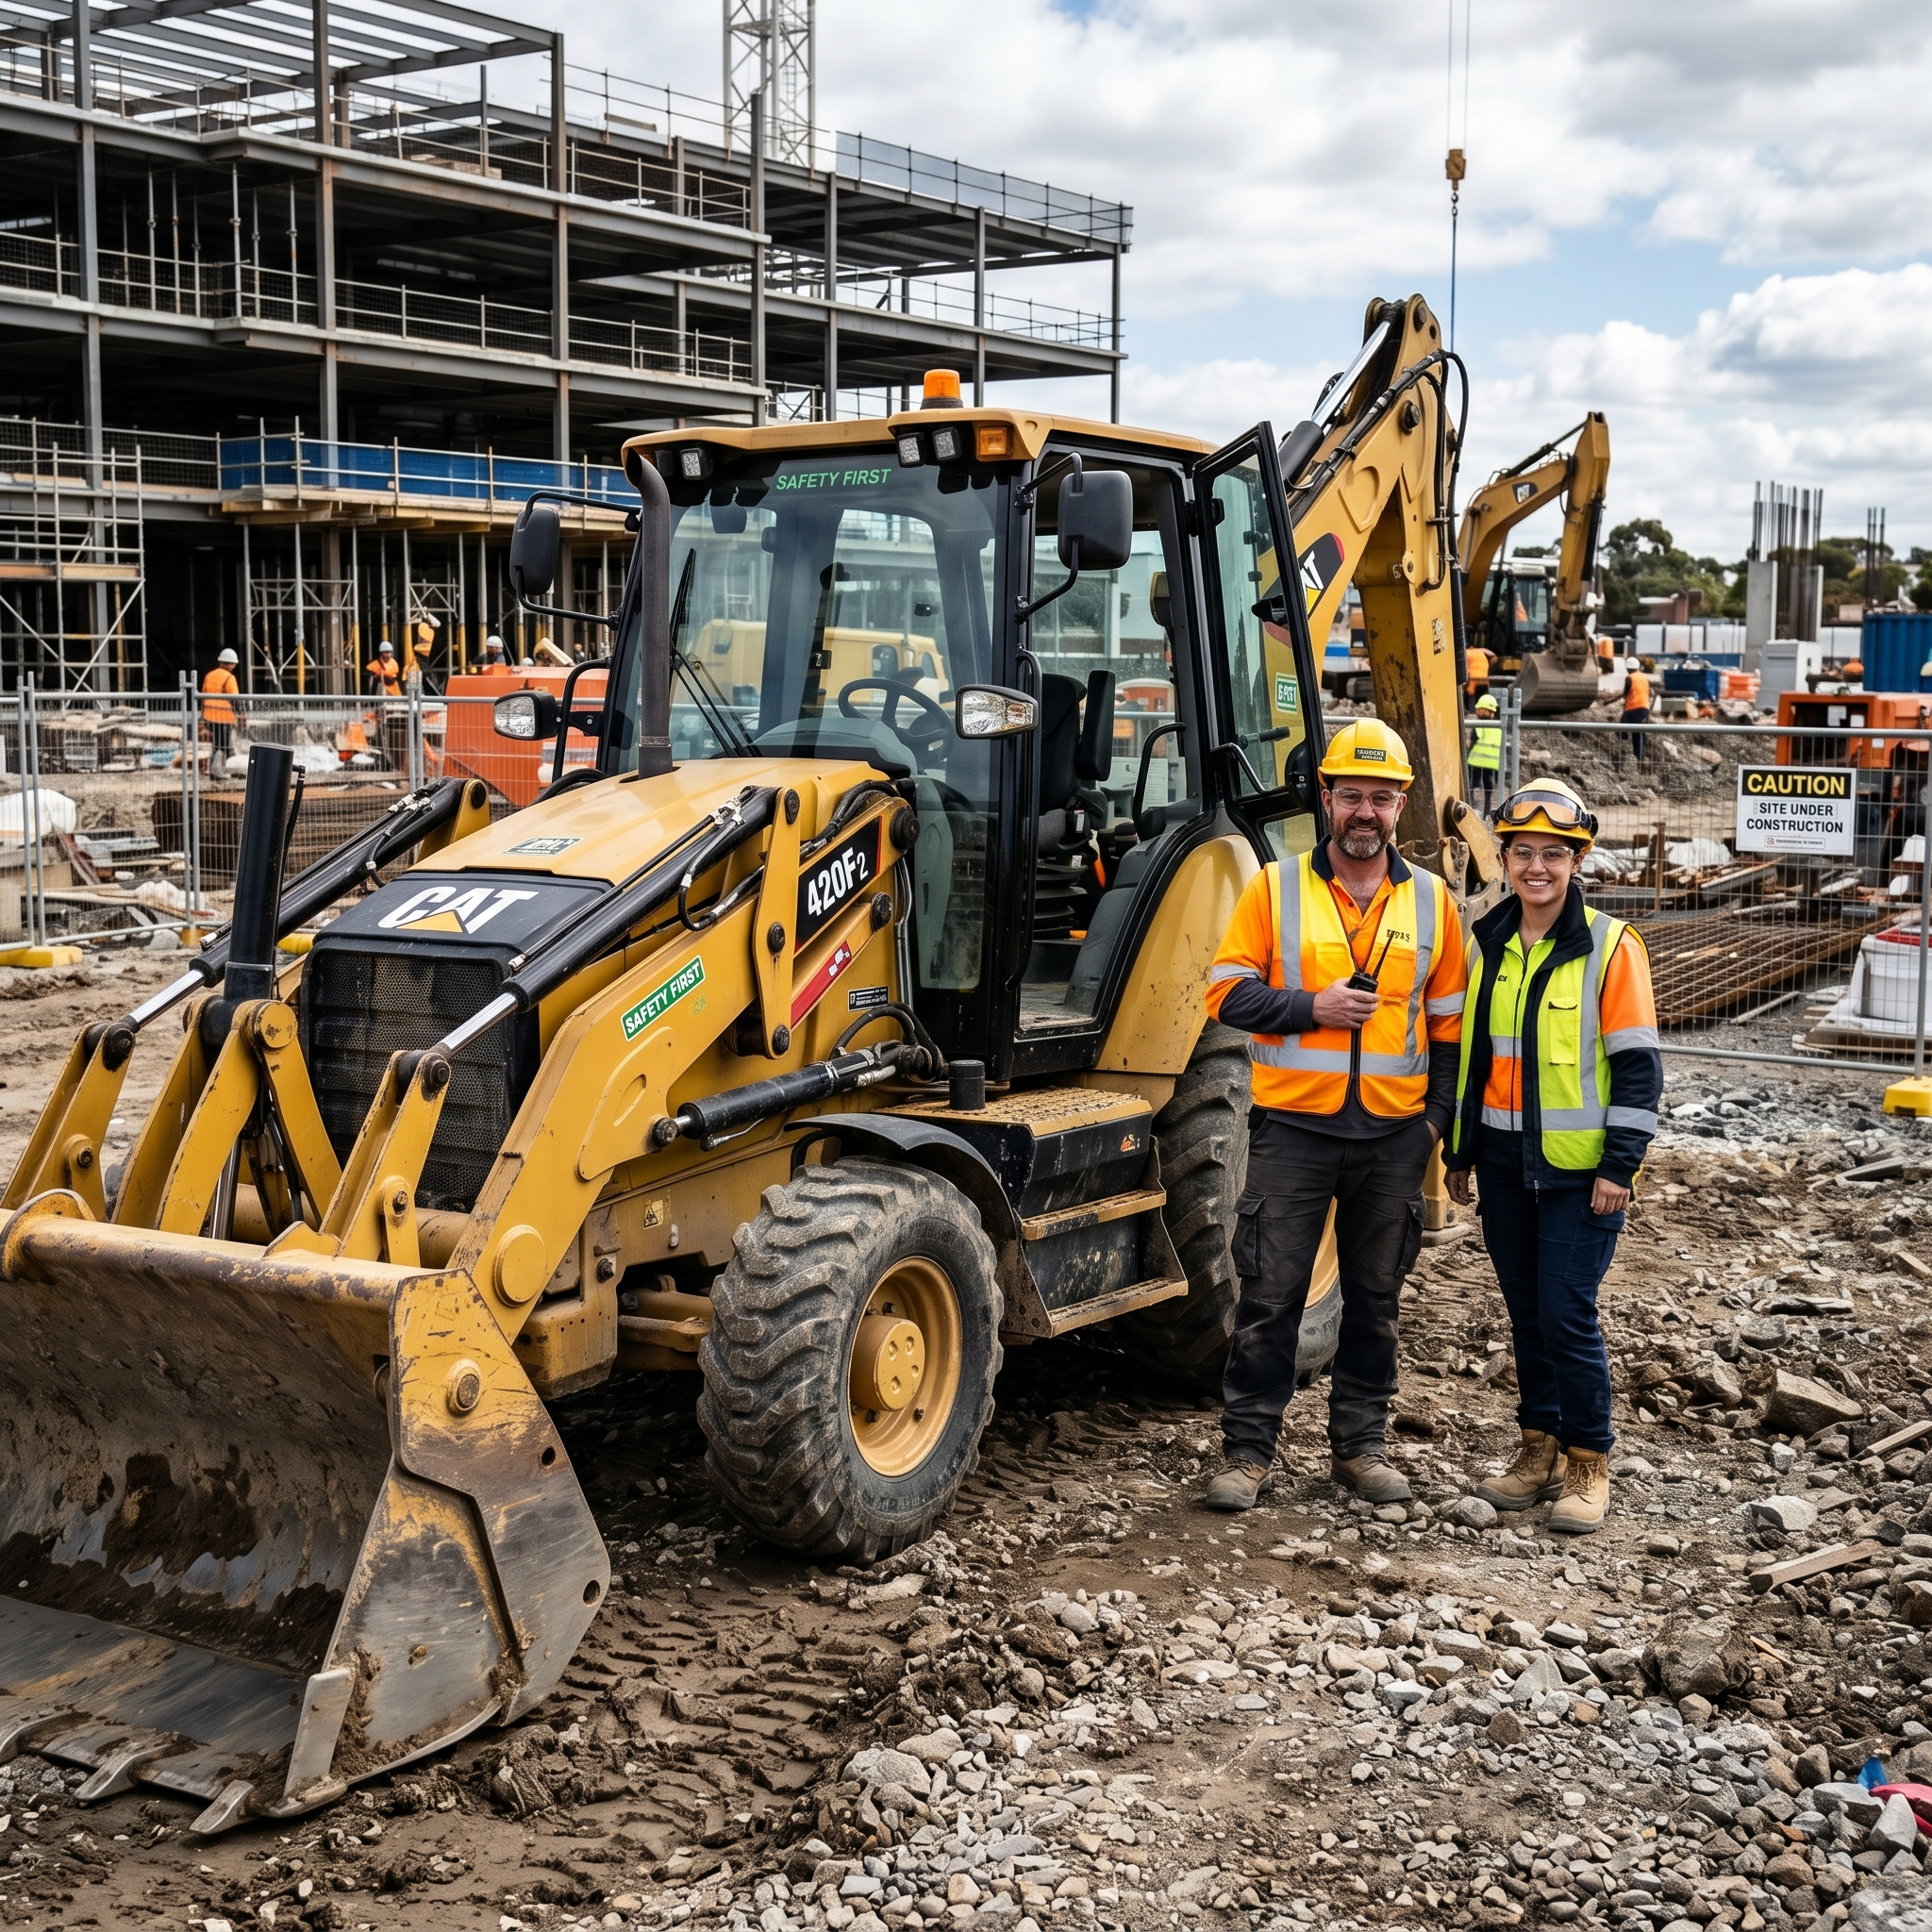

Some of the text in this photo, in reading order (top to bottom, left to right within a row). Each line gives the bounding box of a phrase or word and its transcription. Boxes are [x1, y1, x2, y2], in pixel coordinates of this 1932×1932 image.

[775, 469, 891, 490] SAFETY FIRST
[1747, 773, 1845, 795] CAUTION
[1759, 802, 1833, 816] SITE UNDER
[1746, 818, 1843, 833] CONSTRUCTION
[808, 846, 868, 917] 420F2
[377, 886, 540, 935] CAT
[625, 961, 700, 1034] SAFETY FIRST
